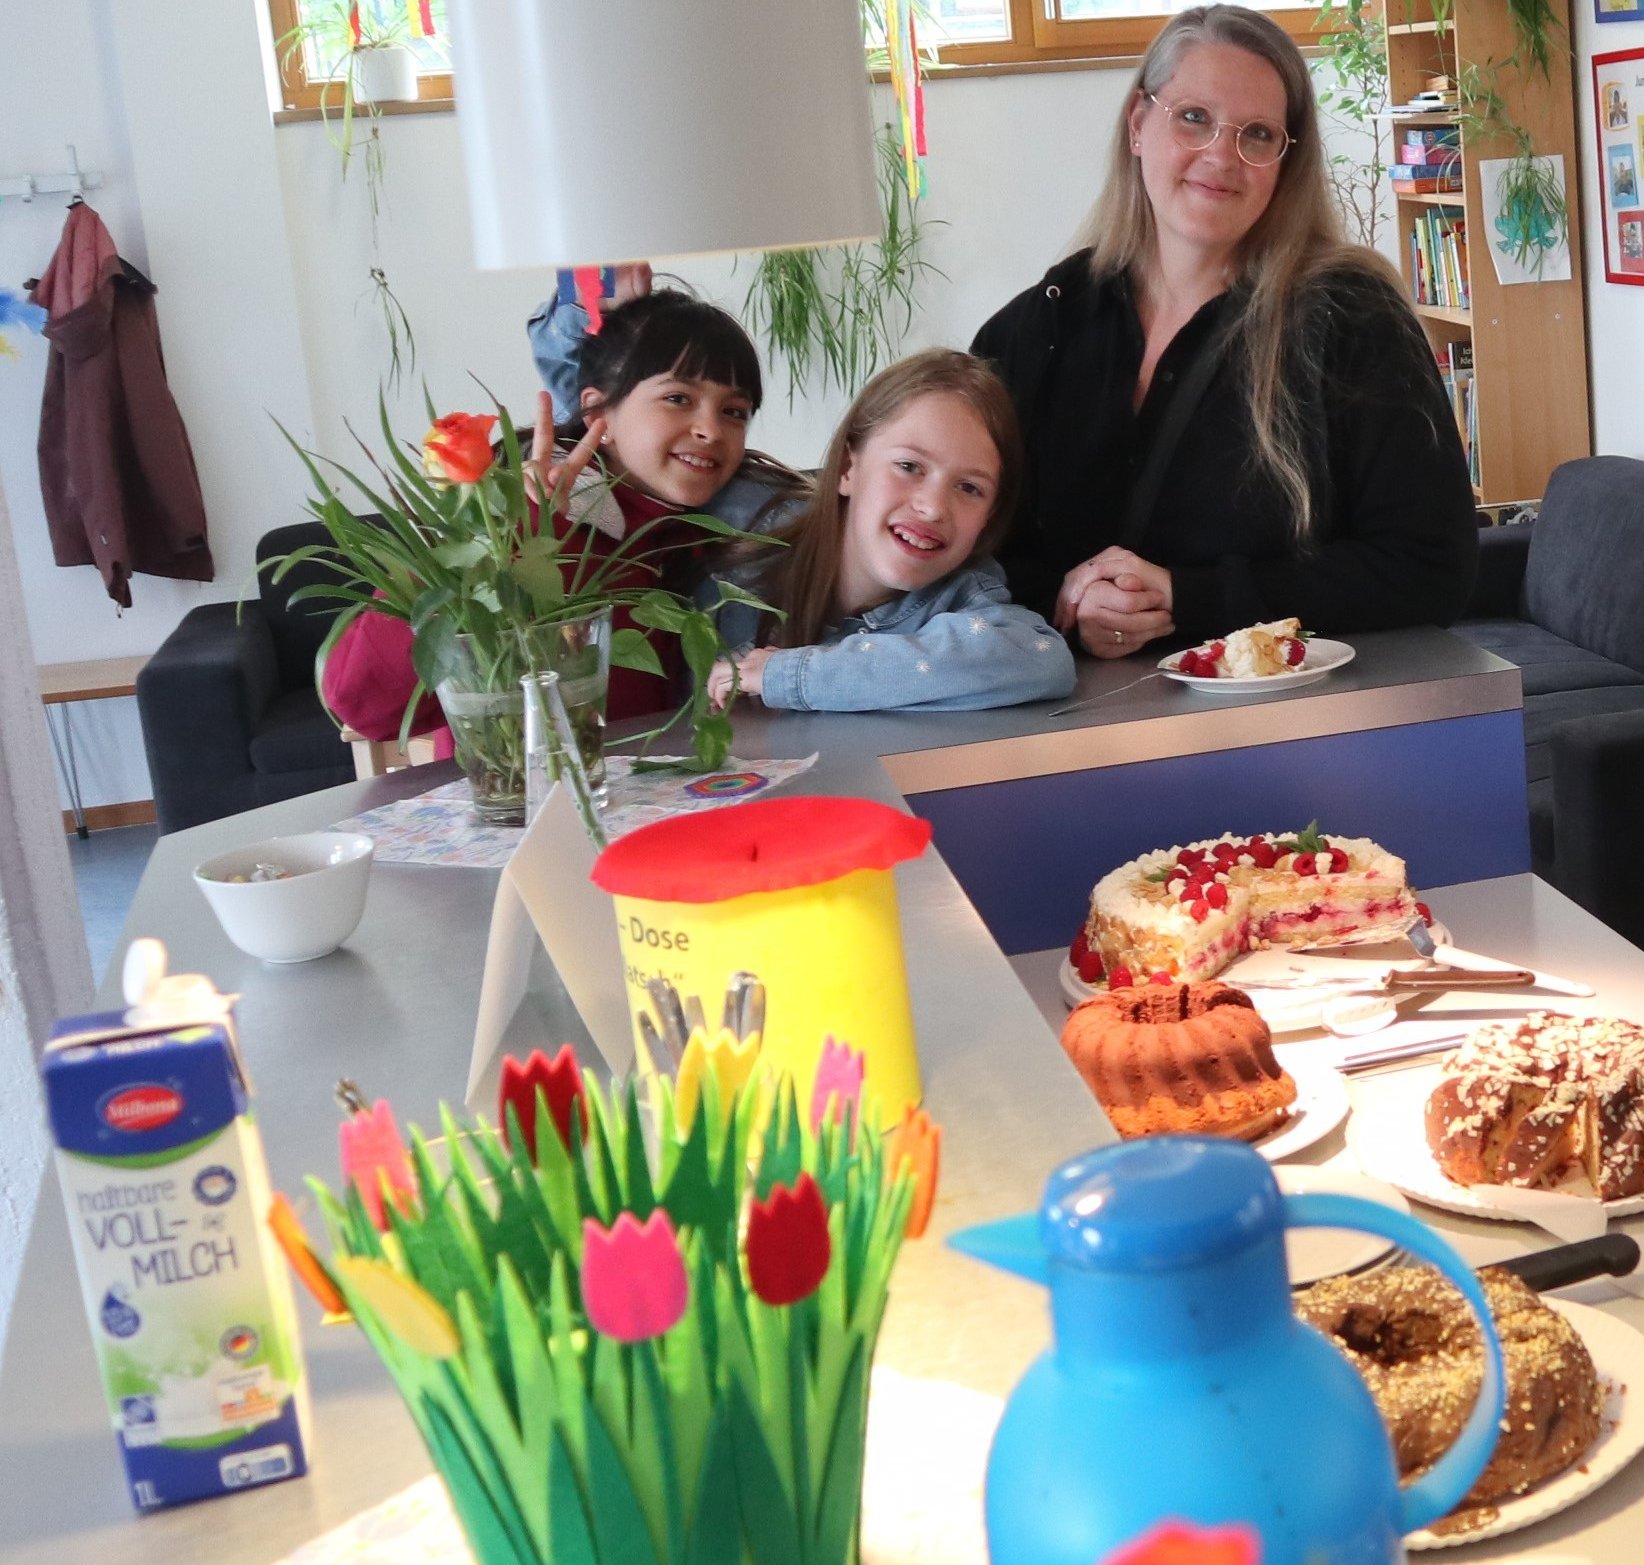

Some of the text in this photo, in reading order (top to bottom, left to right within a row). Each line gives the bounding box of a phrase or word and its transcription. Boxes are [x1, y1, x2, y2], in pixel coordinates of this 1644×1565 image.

[76, 1179, 176, 1212] haltbare
[85, 1208, 189, 1251] VOLL-
[131, 1235, 239, 1289] MILCH
